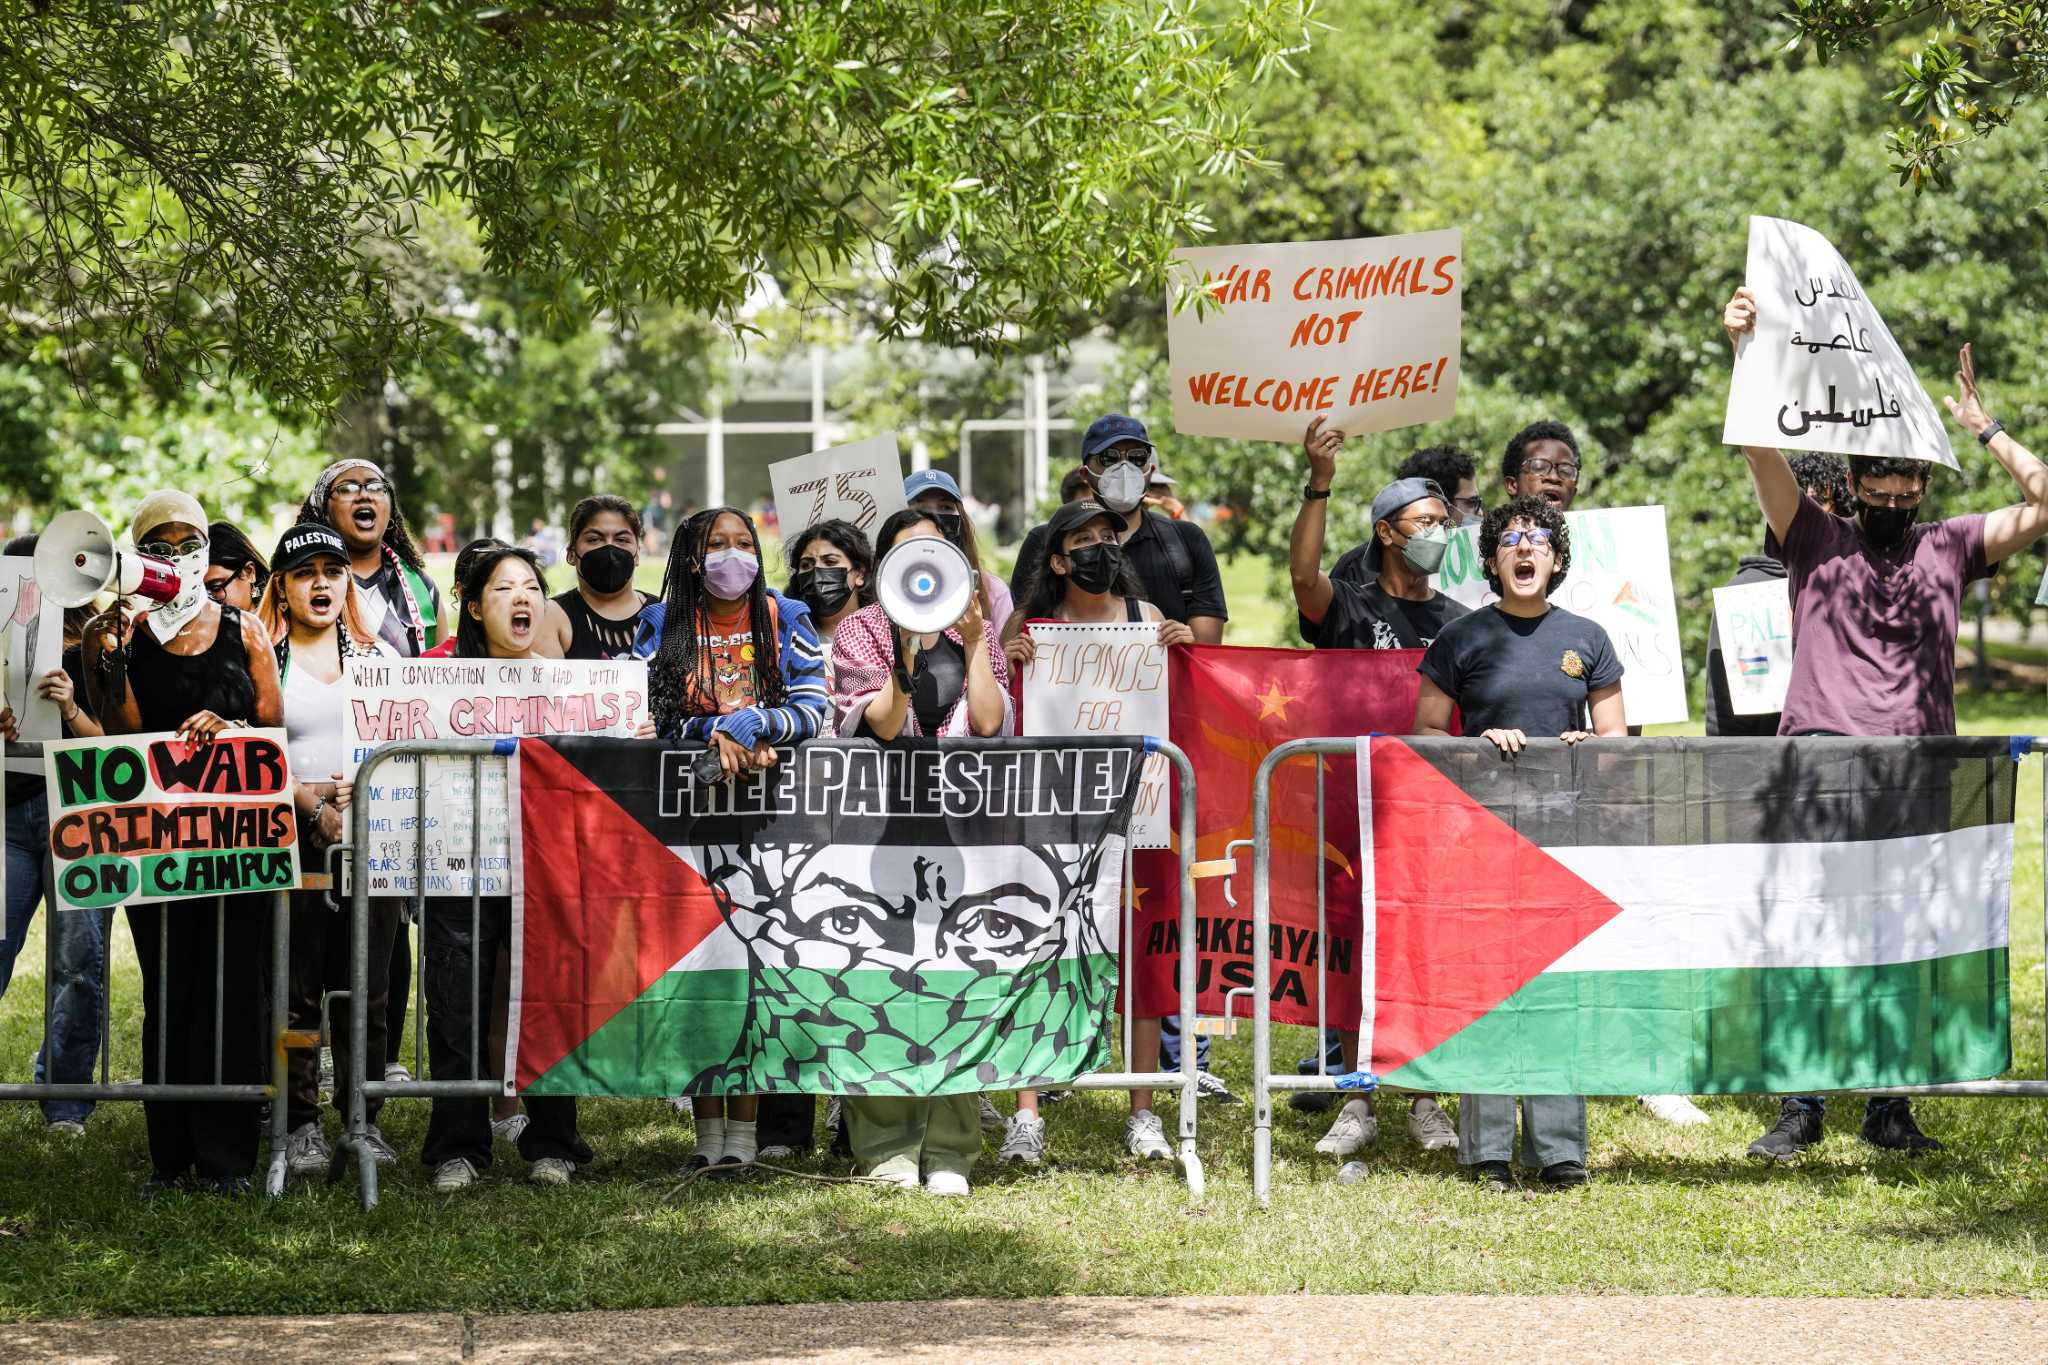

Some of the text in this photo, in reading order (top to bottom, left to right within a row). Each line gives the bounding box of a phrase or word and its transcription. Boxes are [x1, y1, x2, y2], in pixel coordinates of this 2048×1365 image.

[1206, 255, 1457, 304] WAR CRIMINALS
[1290, 311, 1363, 348] NOT
[1791, 312, 1872, 353] عاصمة
[1188, 357, 1449, 412] WELCOME HERE!
[1778, 378, 1901, 436] فلسطين
[789, 467, 880, 531] 75
[284, 531, 344, 554] PALESTINE
[352, 665, 619, 687] WHAT CONVERSATION CAN BE HAD WITH
[1029, 643, 1165, 693] FILIPINOS
[351, 690, 642, 740] WAR CRIMINALS?
[1073, 700, 1123, 731] FOR
[54, 741, 284, 804] NO WAR
[804, 745, 1132, 817] PALESTINE!
[52, 804, 293, 860] CRIMINALS
[65, 852, 293, 898] ON CAMPUS
[447, 857, 466, 871] 400
[1173, 958, 1308, 1006] USA
